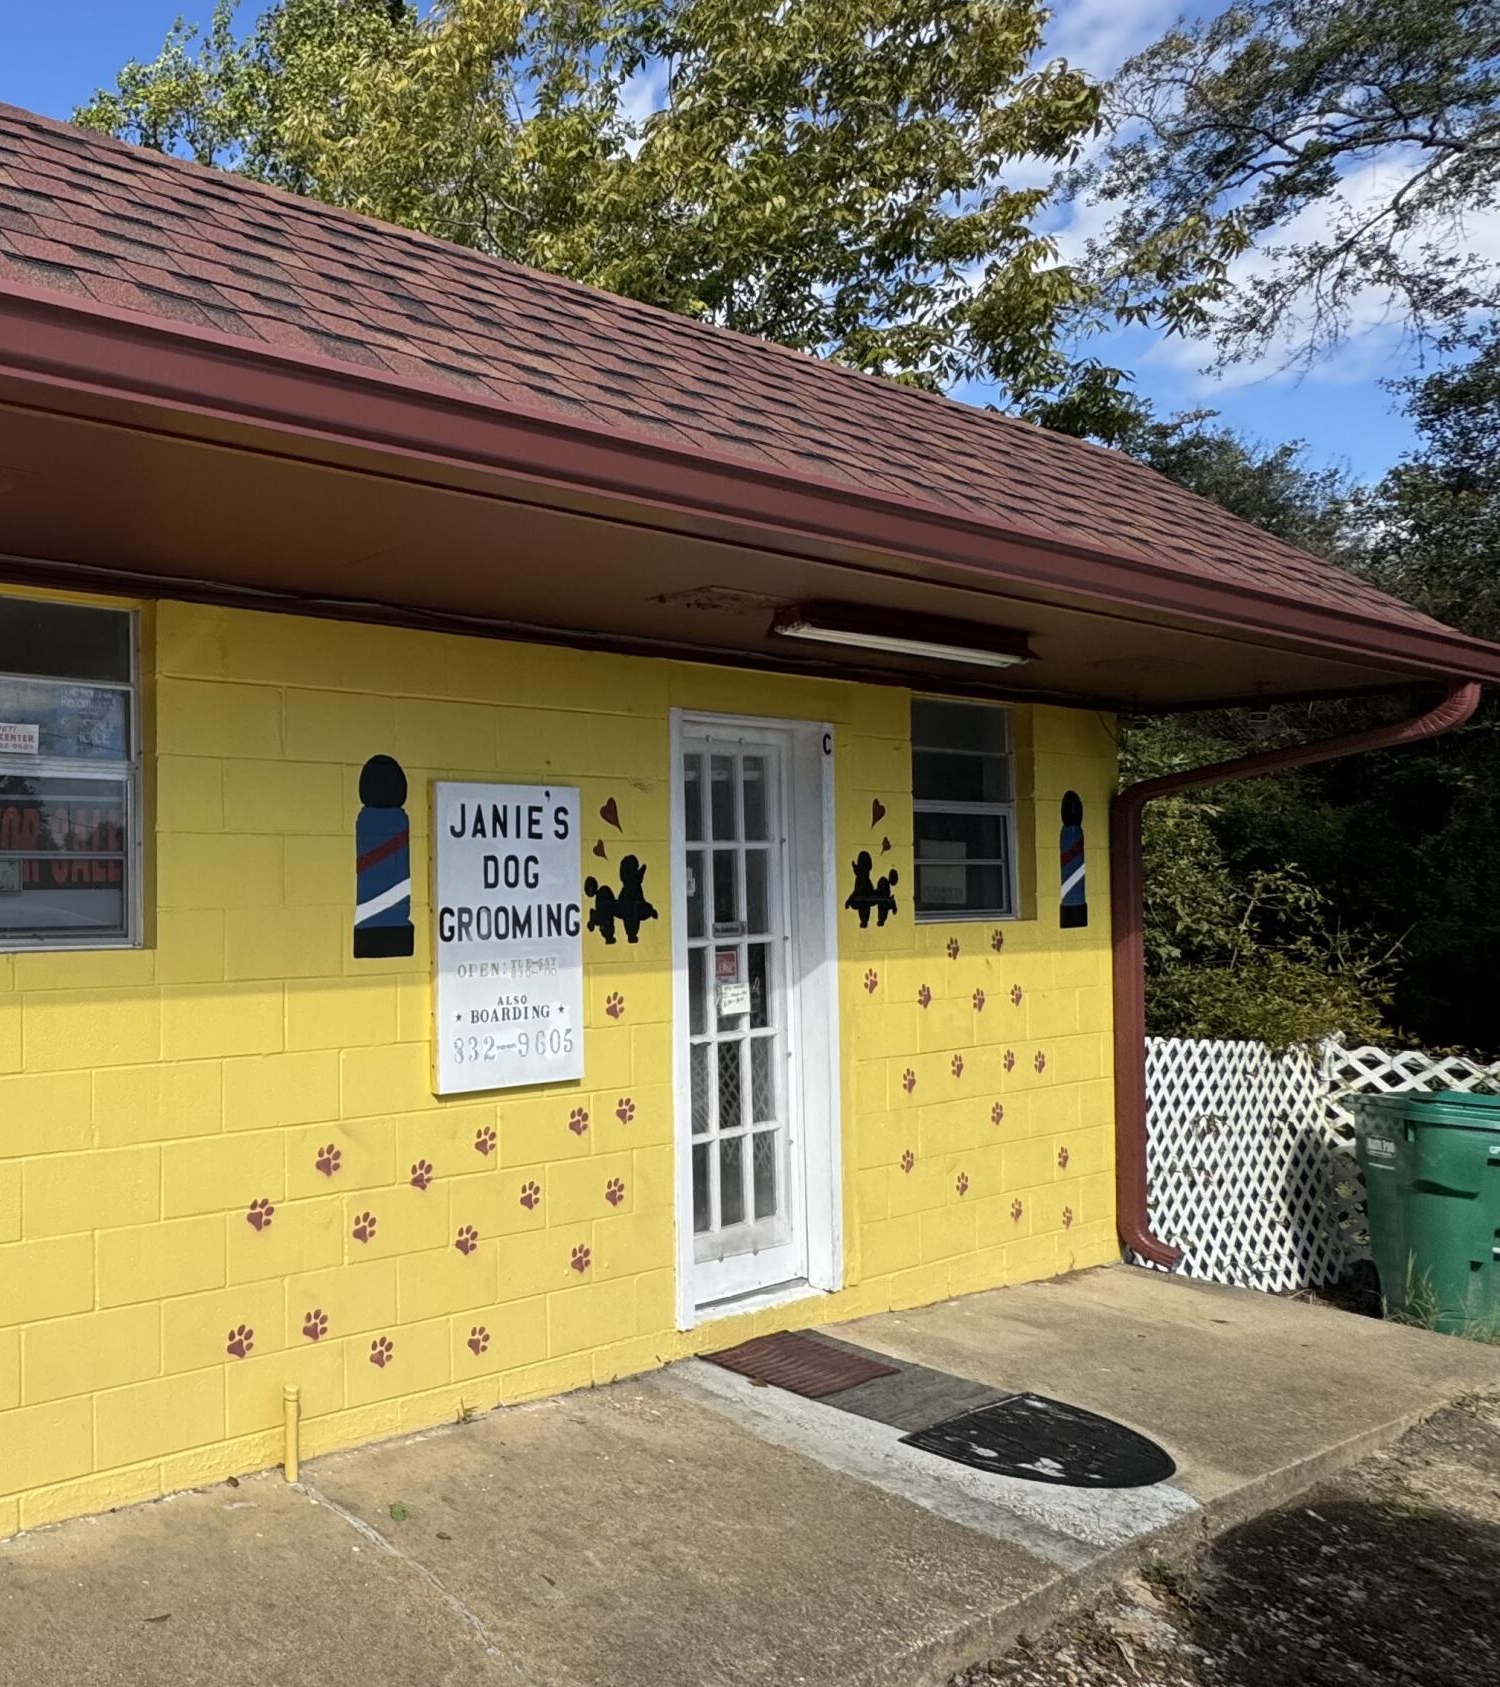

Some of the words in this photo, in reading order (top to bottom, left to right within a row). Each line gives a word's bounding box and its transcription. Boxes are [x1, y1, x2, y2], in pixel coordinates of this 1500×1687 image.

[0, 733, 35, 744] CENTER
[822, 733, 832, 756] C
[450, 790, 569, 840] JANIE'S
[483, 855, 539, 889] DOG
[439, 903, 581, 942] GROOMING
[471, 1004, 551, 1024] BOARDING
[497, 994, 528, 1006] ALSO
[453, 1028, 574, 1064] 832-9605
